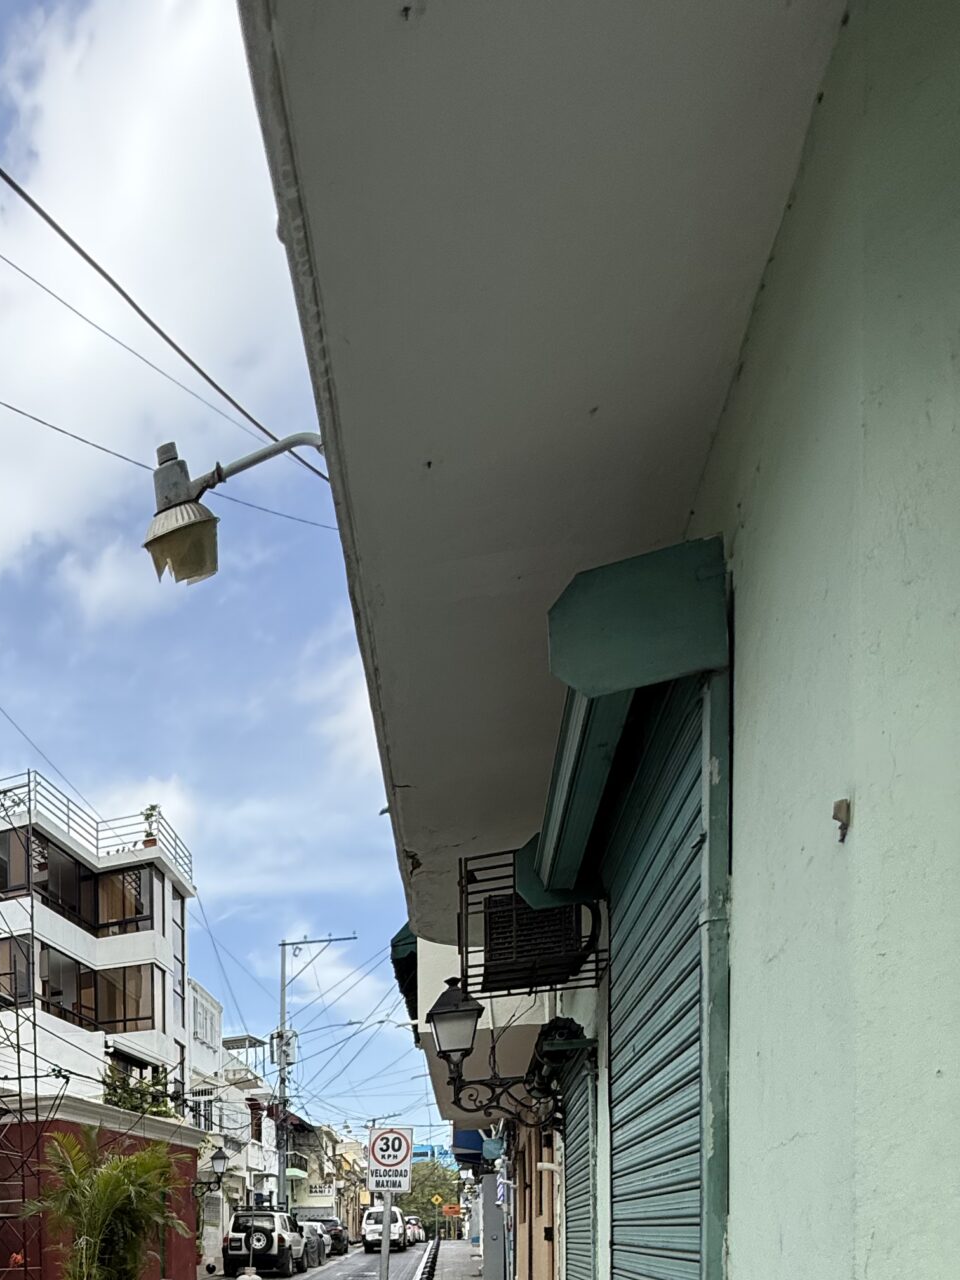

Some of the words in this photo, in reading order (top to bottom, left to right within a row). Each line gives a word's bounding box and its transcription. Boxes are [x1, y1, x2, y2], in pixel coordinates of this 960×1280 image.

[379, 1136, 402, 1152] 30
[370, 1169, 408, 1178] VELOCIDAD
[375, 1180, 402, 1188] MAXIMA
